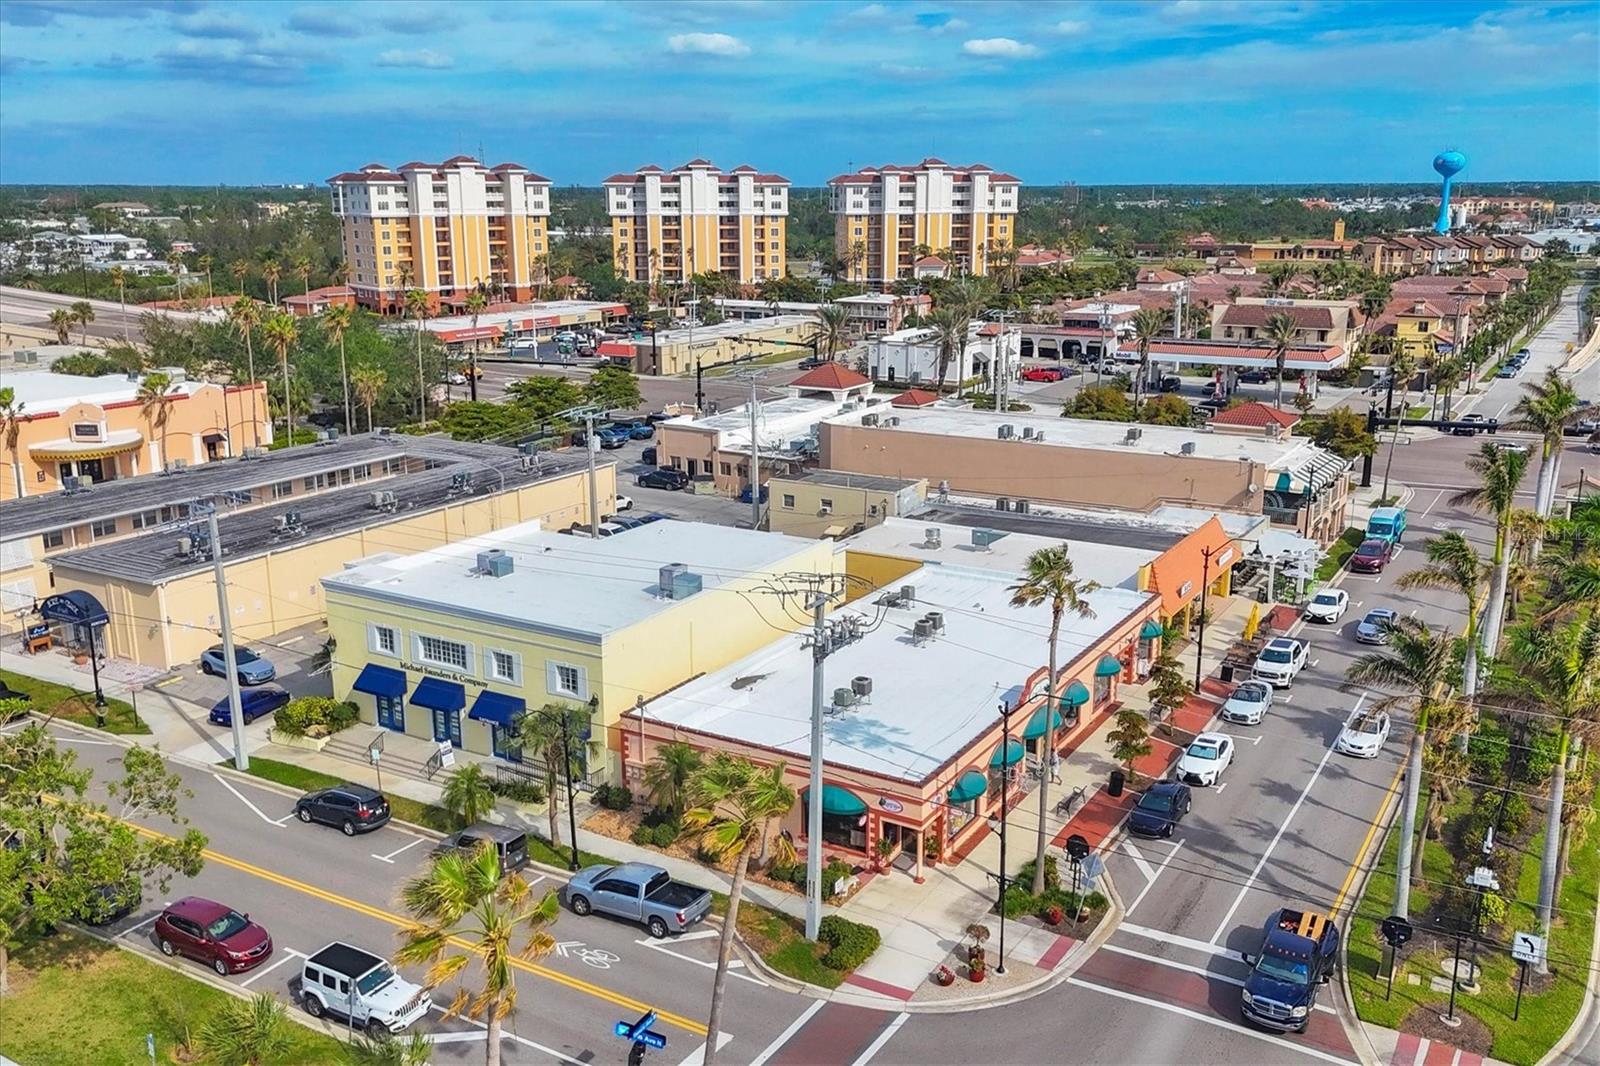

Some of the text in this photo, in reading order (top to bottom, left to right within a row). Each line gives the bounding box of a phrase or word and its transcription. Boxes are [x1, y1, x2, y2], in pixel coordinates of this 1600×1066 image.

[400, 661, 423, 673] Michael
[424, 667, 451, 680] Saunders
[460, 675, 489, 688] Company
[1516, 951, 1535, 961] ONLY
